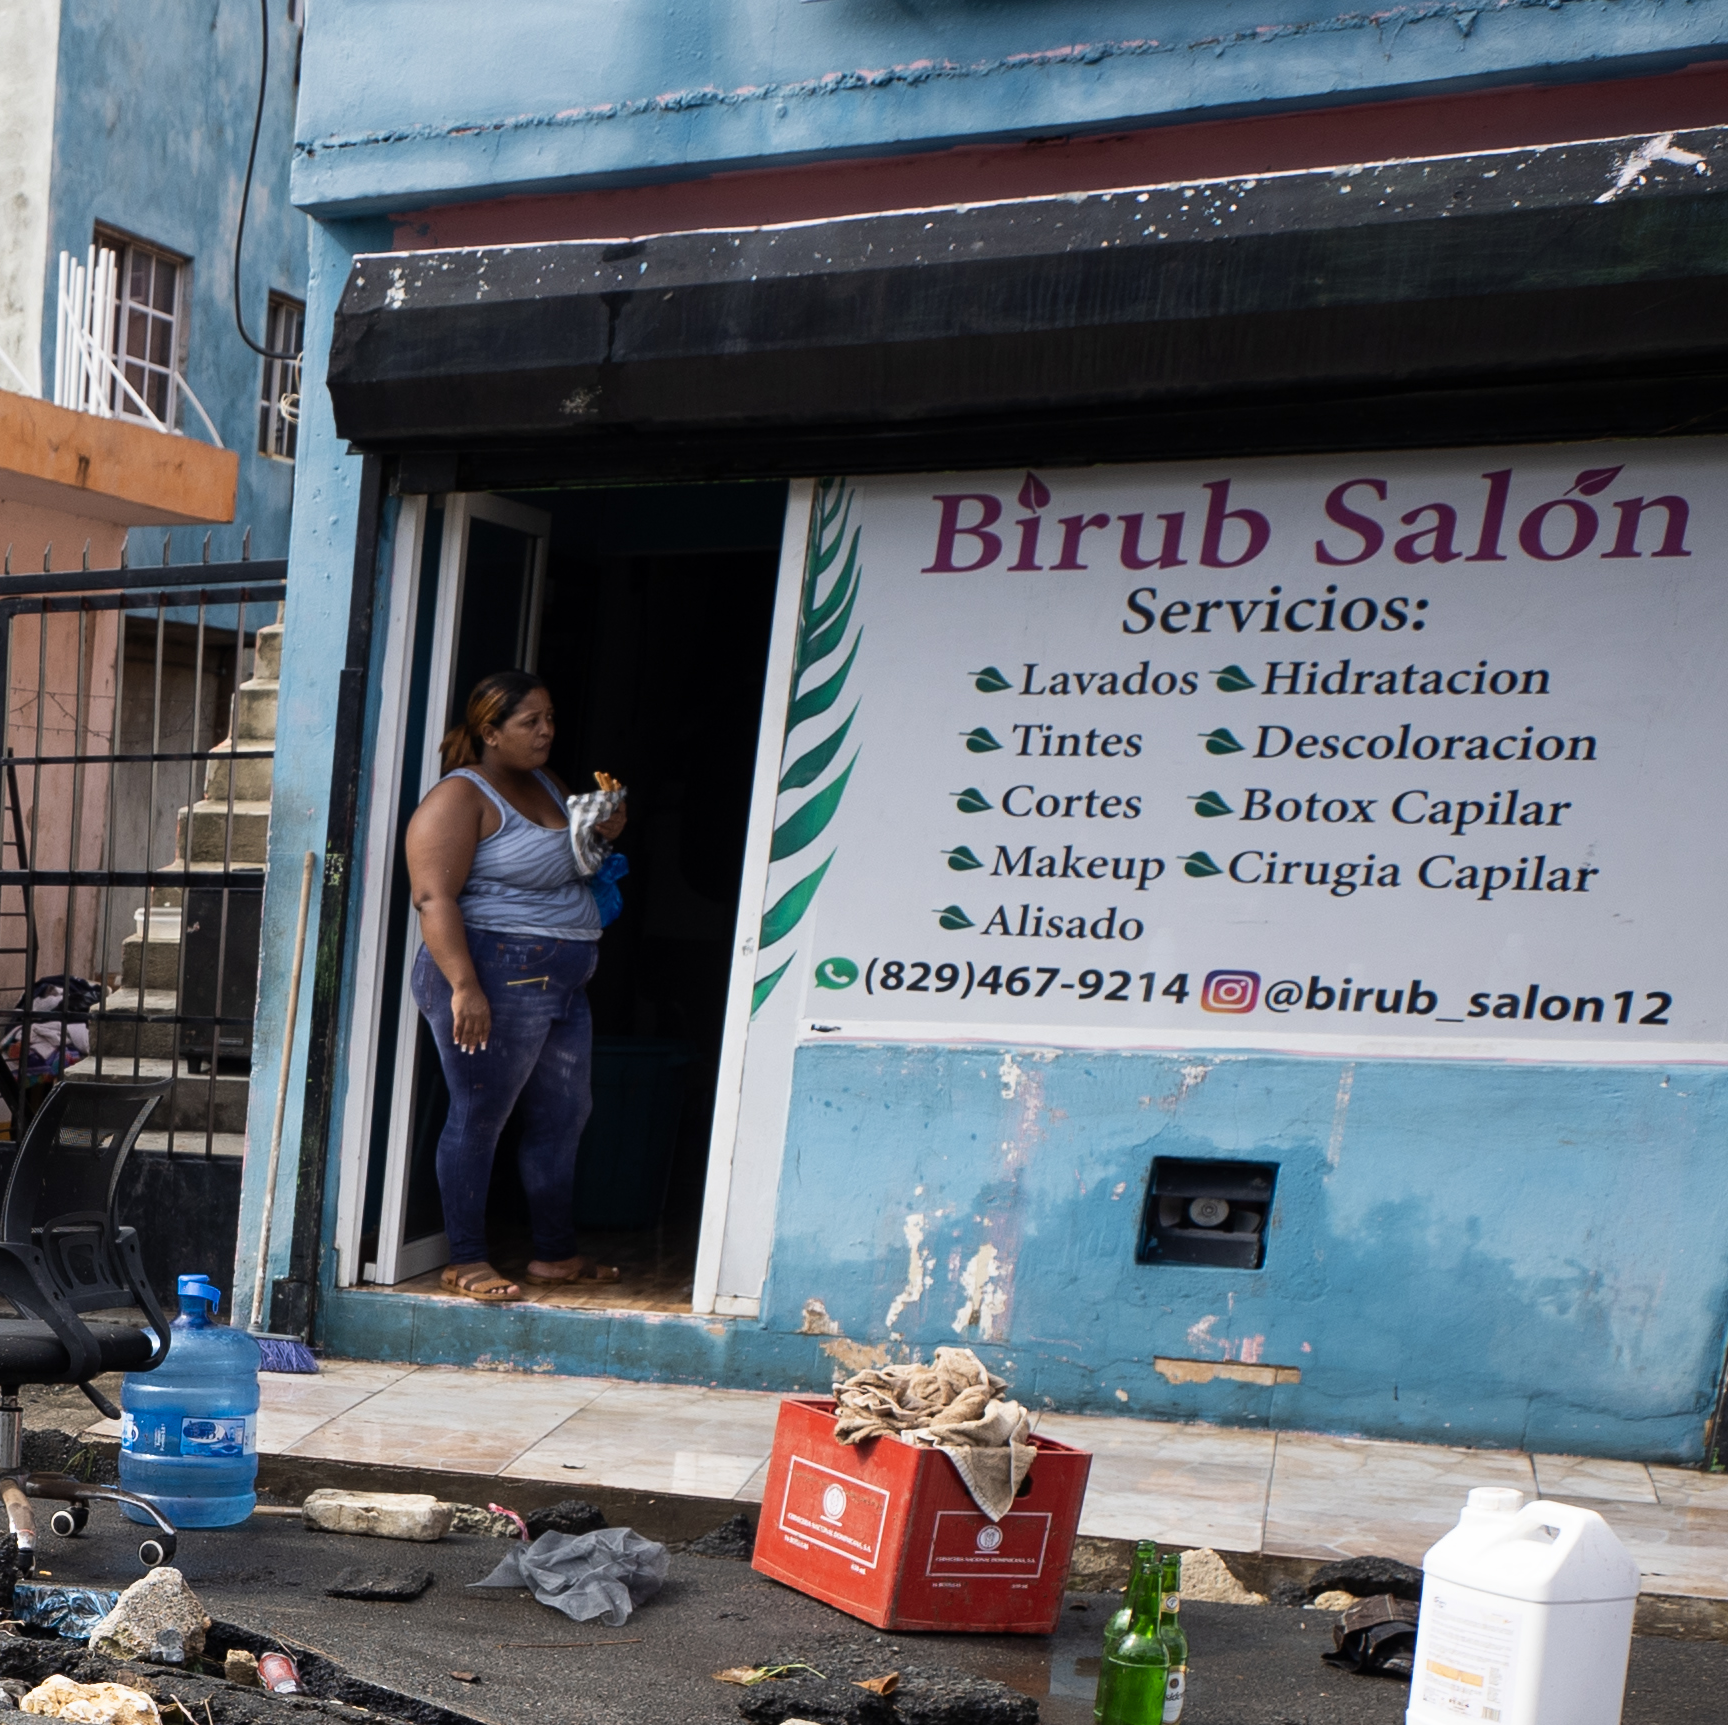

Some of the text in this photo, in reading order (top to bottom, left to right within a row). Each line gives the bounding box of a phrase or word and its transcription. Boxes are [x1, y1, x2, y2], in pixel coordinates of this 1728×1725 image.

[921, 464, 1693, 575] Birub Salón
[1121, 584, 1428, 637] Servicios:
[1019, 661, 1199, 697] Lavados
[1261, 661, 1551, 697] Hidratacion
[1012, 721, 1144, 758] Tintes
[1253, 724, 1599, 761] Descoloracion
[1001, 785, 1142, 819] Cortes
[1240, 787, 1572, 835] Botox Capilar
[989, 844, 1165, 890] Makeup
[1228, 849, 1599, 902] Cirugia Capilar
[981, 903, 1145, 942] Alisado
[864, 958, 1191, 1006] (829)467-9214
[1265, 976, 1673, 1026] @birub_salon12
